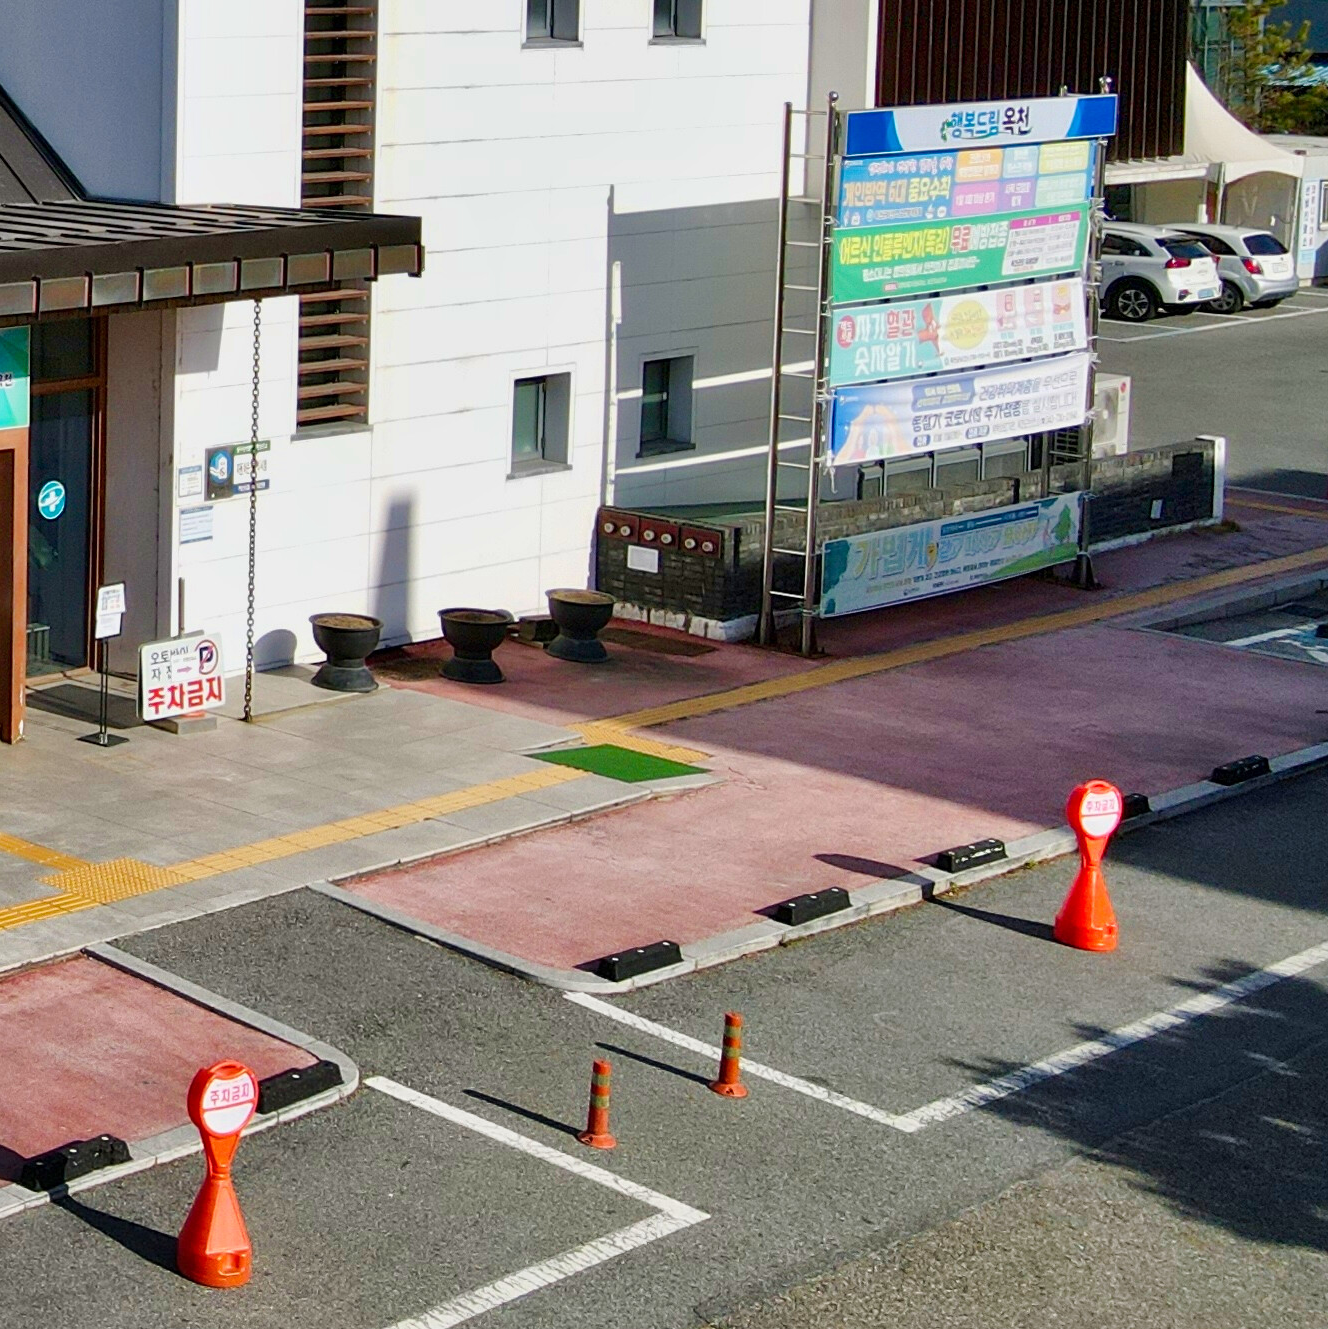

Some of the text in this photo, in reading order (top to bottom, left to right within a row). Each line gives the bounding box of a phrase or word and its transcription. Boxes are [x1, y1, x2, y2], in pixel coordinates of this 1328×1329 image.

[949, 106, 1031, 140] 행복드림 옥천
[854, 339, 917, 376] 숫자알기
[147, 676, 222, 715] 주차금지
[210, 1083, 250, 1106] 주차금지
